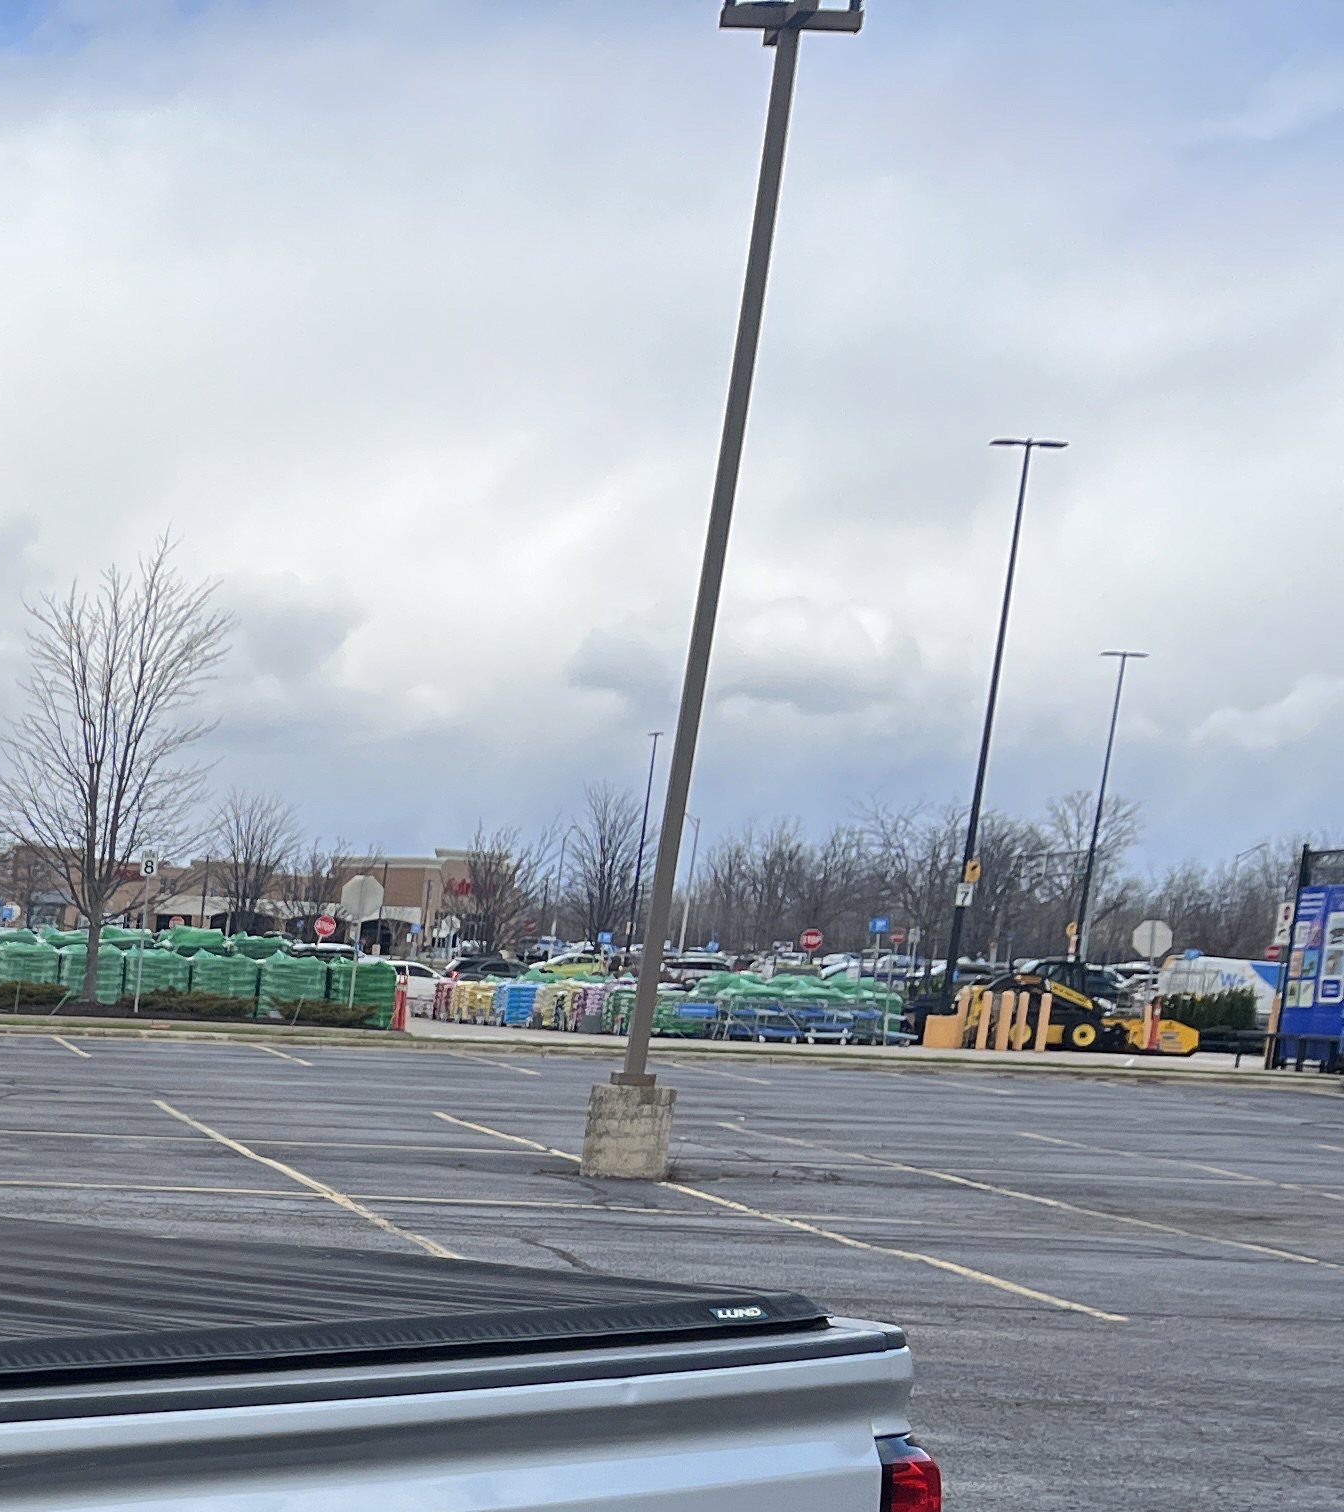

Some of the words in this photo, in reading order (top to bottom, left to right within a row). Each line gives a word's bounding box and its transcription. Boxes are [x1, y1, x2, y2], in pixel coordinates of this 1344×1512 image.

[144, 860, 154, 875] 8
[960, 891, 969, 906] 7
[716, 1306, 763, 1319] LUND
